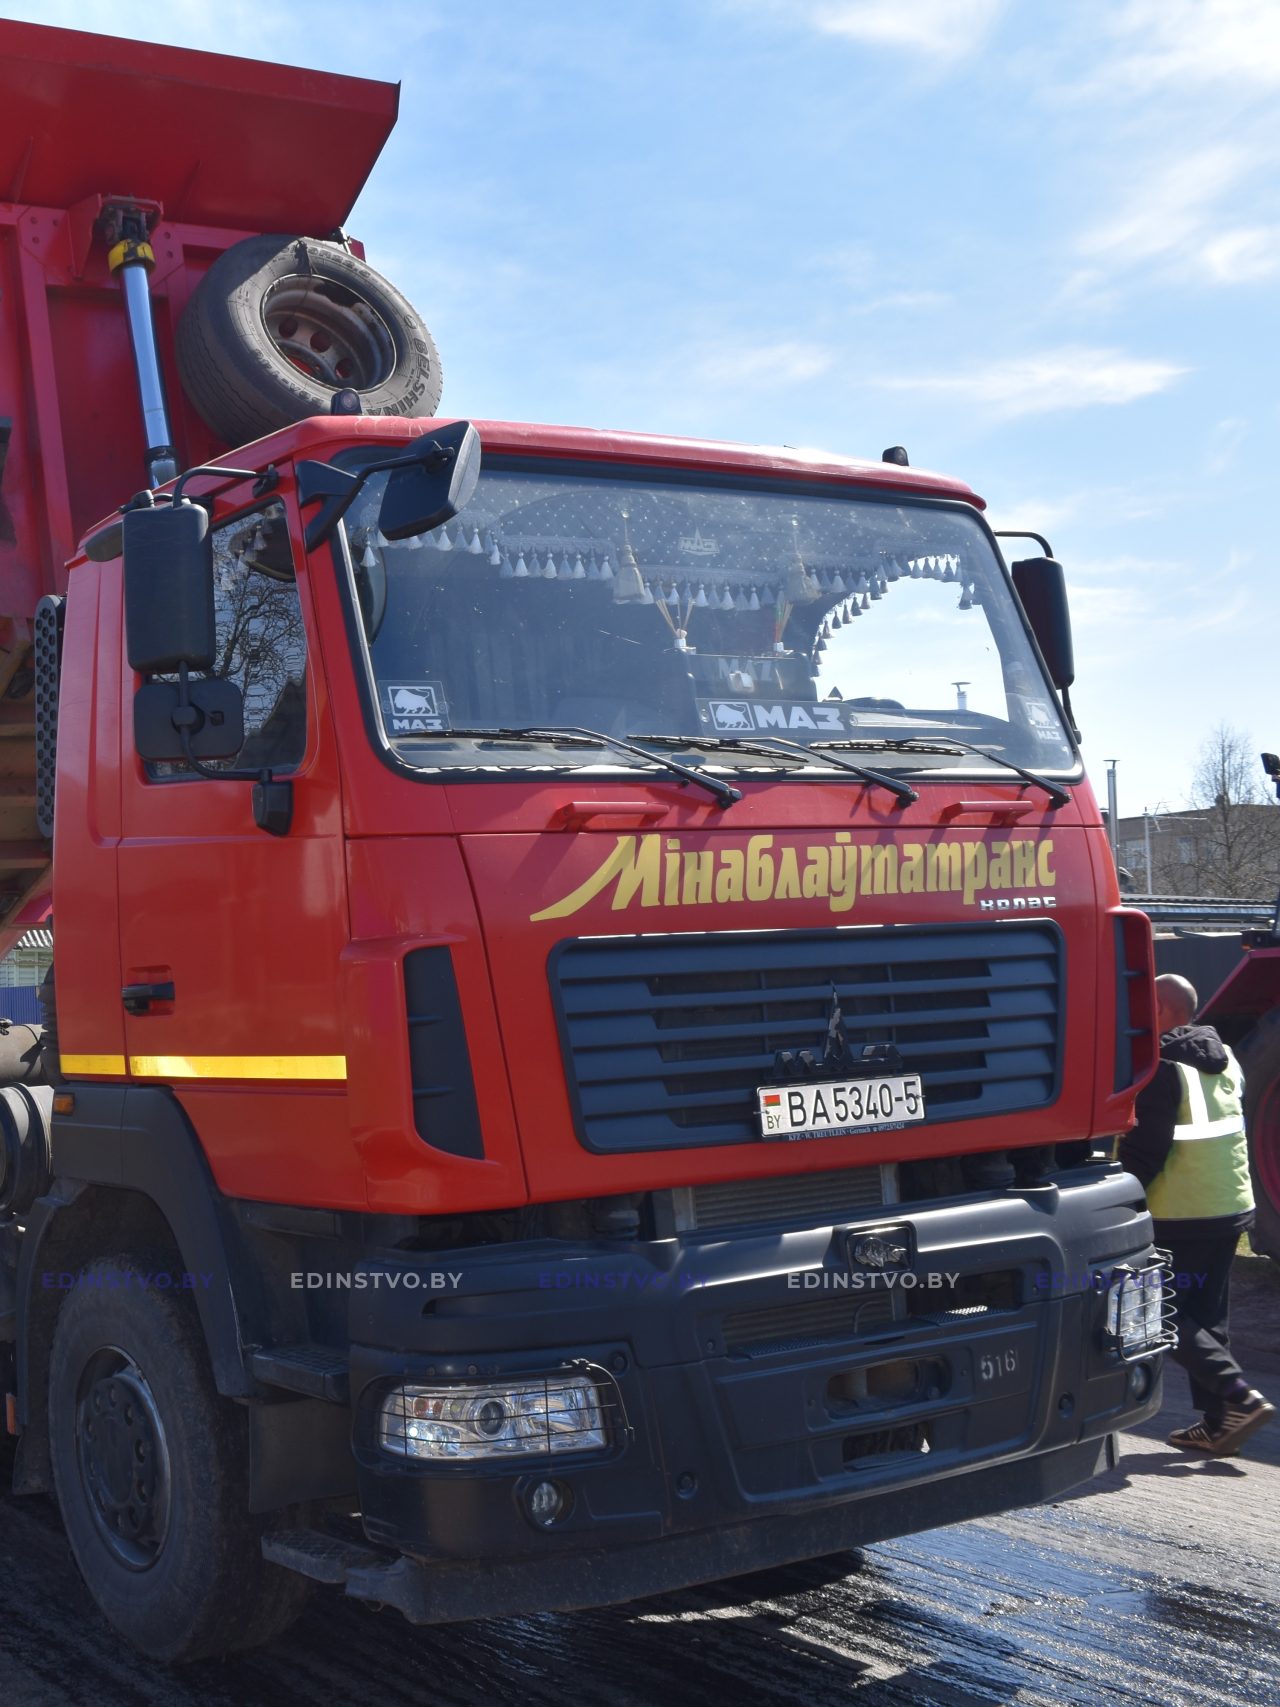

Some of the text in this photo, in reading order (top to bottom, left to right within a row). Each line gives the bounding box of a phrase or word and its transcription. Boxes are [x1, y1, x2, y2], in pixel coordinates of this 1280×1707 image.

[365, 337, 431, 416] BELSHINA
[392, 718, 443, 730] МАЗ
[753, 704, 845, 731] МАЗ
[530, 832, 1057, 922] Мінаблаўтатранс
[767, 1114, 781, 1130] BY
[980, 1349, 1016, 1379] 516
